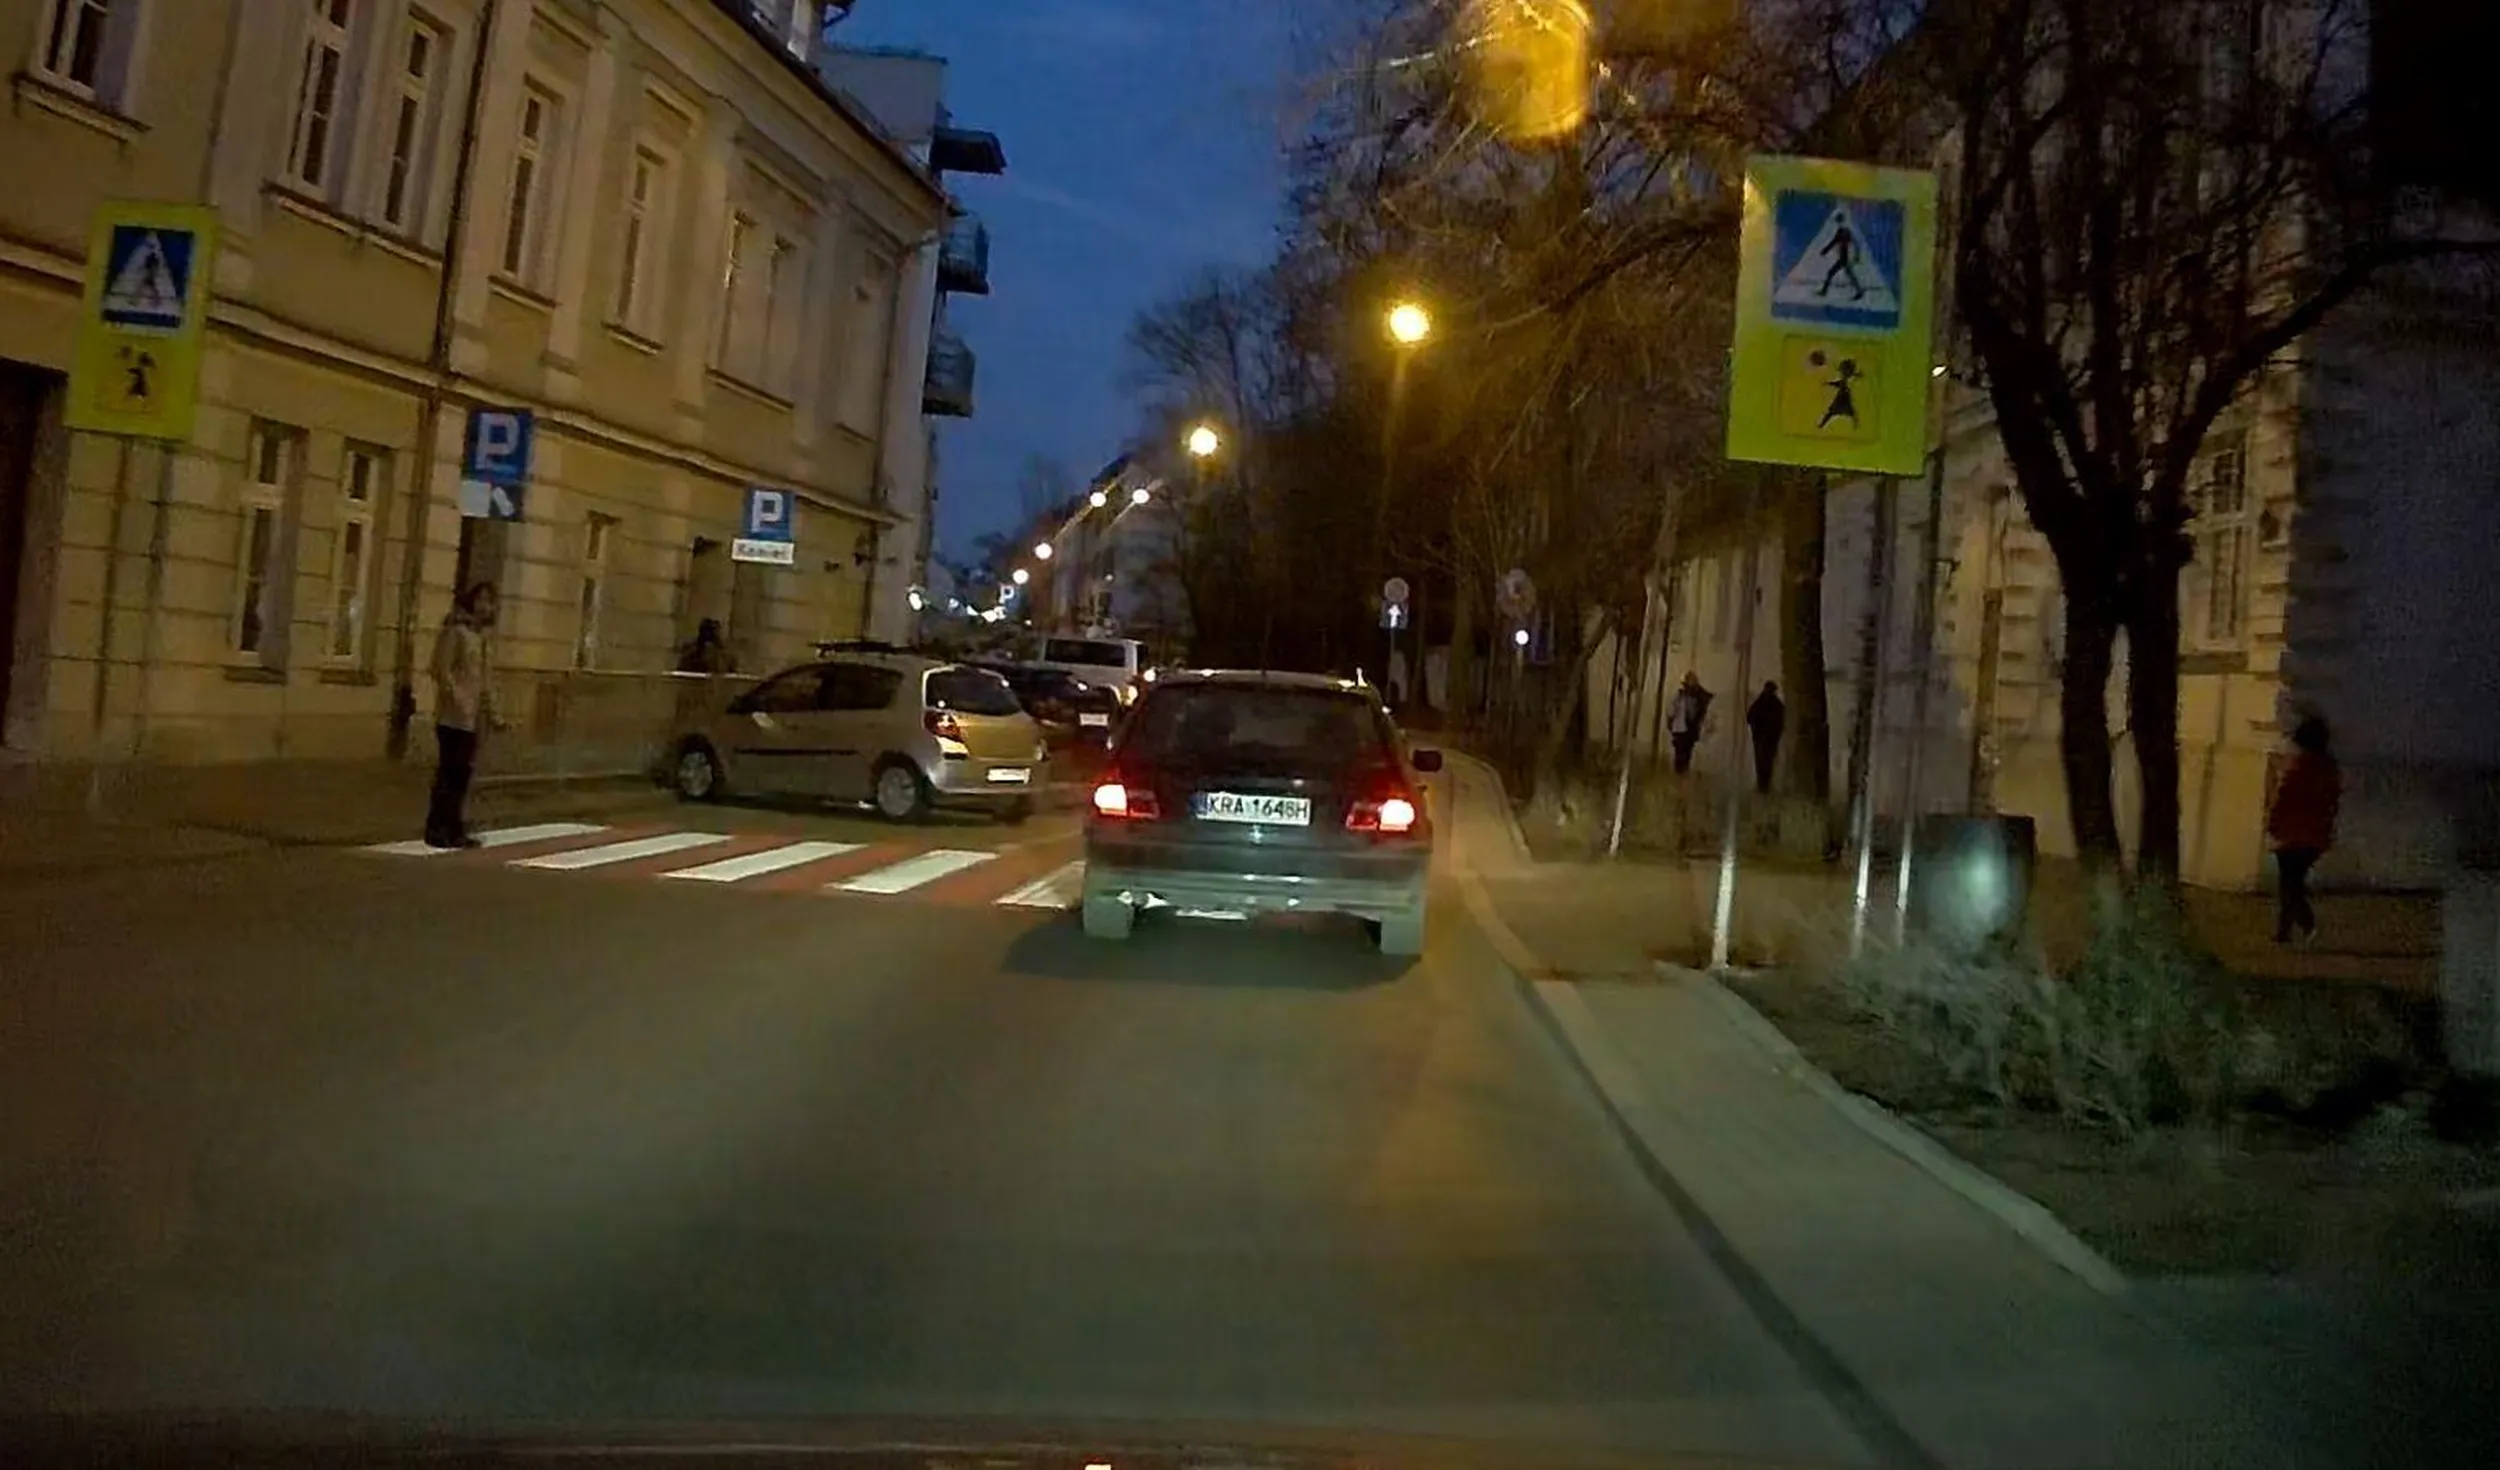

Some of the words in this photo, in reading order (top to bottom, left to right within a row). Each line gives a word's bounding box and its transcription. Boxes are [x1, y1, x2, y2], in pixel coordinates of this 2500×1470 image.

[474, 412, 519, 470] P
[751, 490, 784, 533] P
[999, 582, 1014, 603] P
[1209, 796, 1244, 815] KRA
